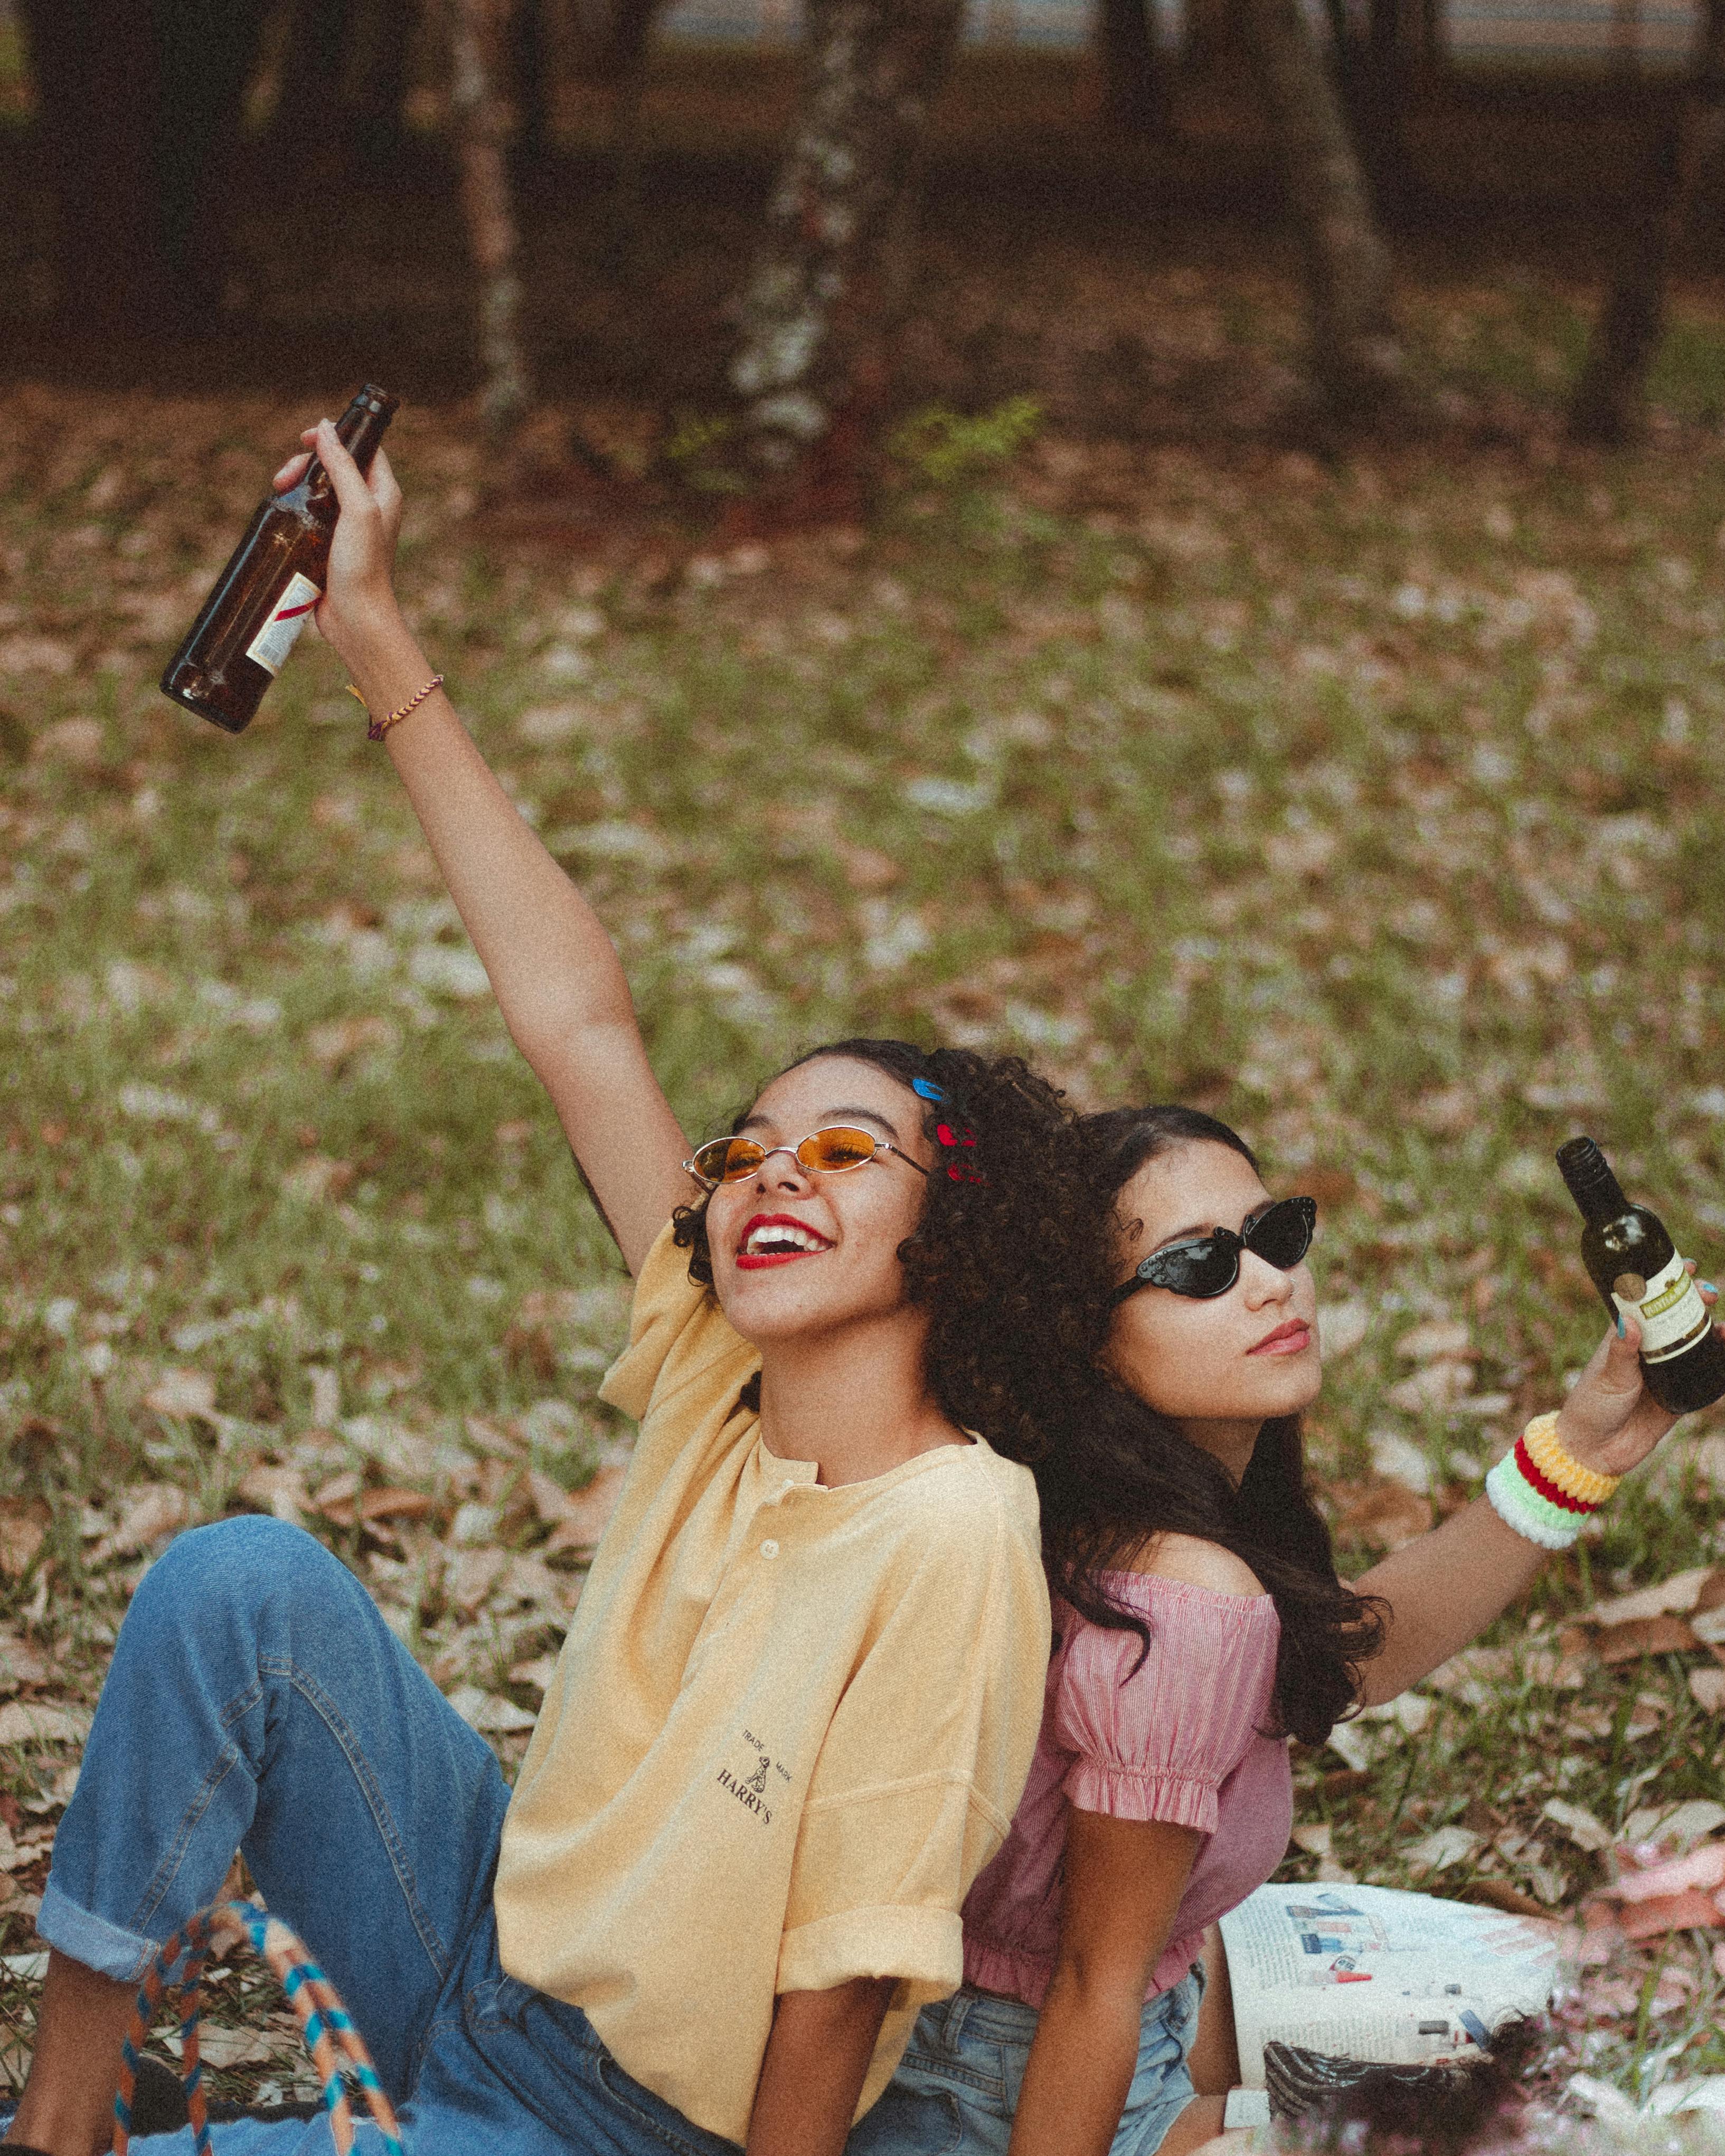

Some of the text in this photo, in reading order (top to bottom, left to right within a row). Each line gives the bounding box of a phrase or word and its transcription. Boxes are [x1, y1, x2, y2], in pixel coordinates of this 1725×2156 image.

[742, 1729, 793, 1783] TRADE MARK
[717, 1769, 772, 1824] HARRY'S
